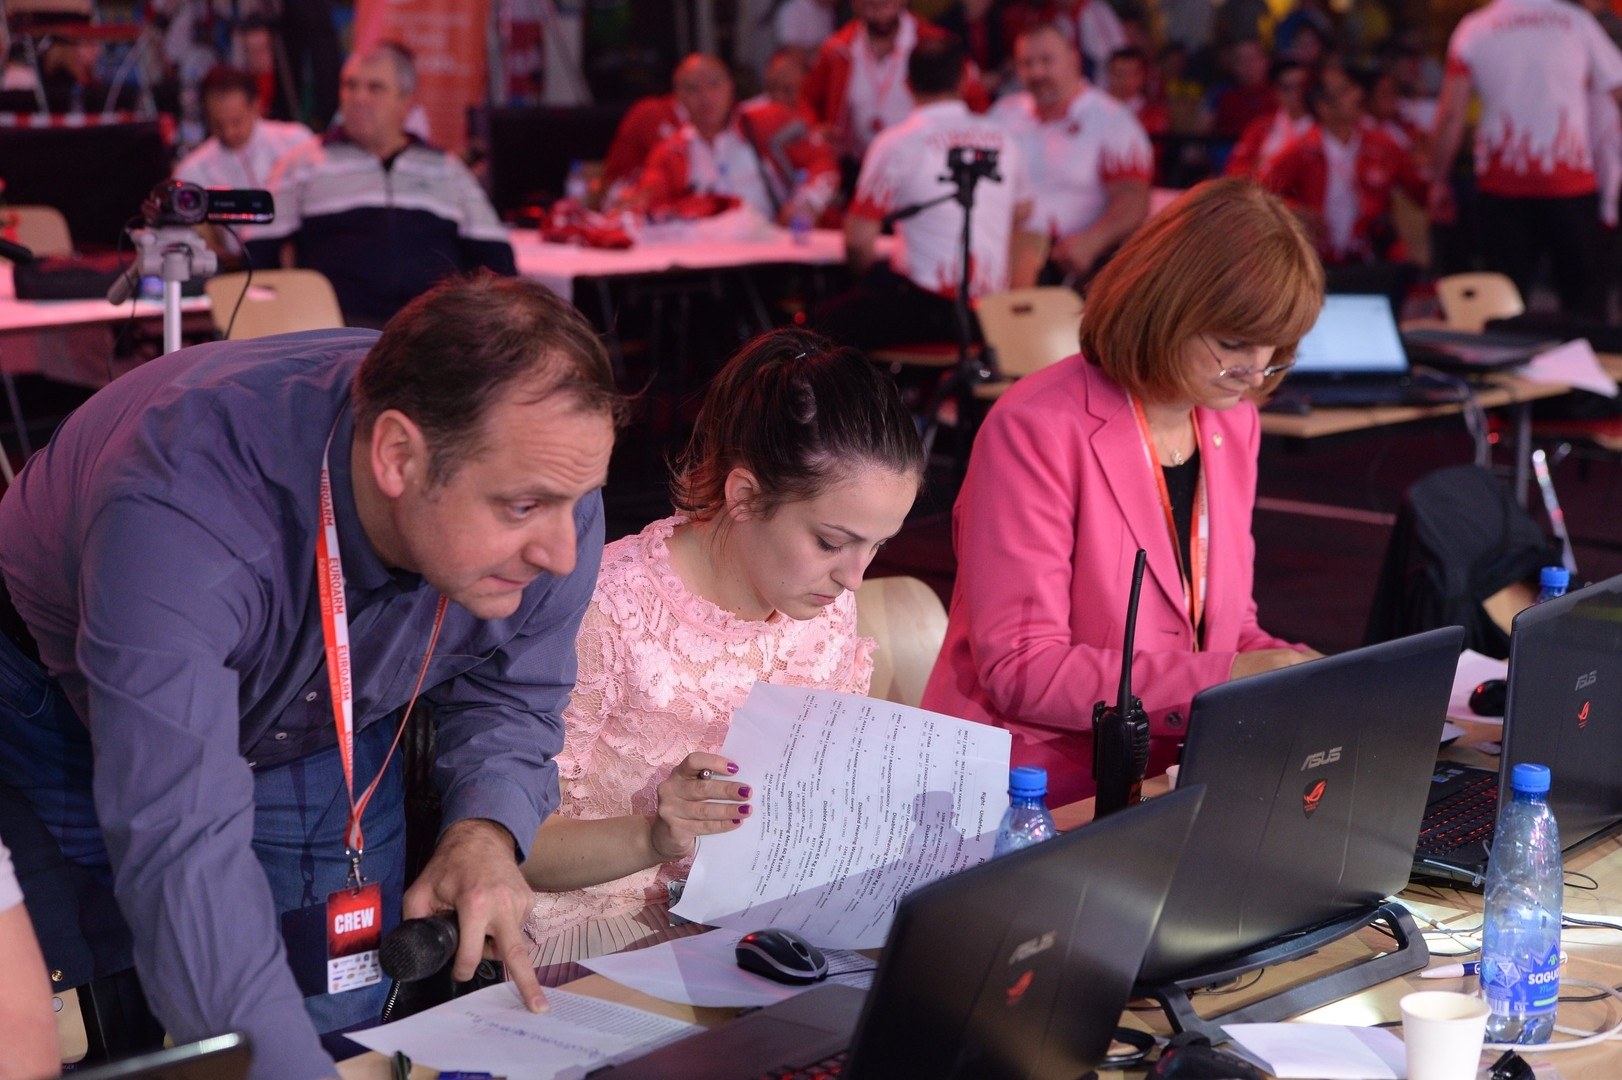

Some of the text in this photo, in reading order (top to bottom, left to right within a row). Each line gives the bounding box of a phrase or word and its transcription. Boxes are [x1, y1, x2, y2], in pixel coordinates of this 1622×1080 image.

[320, 469, 334, 526] EUROARM
[330, 557, 344, 615] EUROARM
[322, 596, 332, 616] 2017
[338, 645, 350, 700] EUROARM
[1575, 670, 1597, 692] ASUS
[1300, 746, 1342, 772] ASUS
[889, 812, 897, 834] Disabled
[975, 810, 984, 841] Undefeated
[852, 824, 860, 845] Hearing
[898, 834, 906, 855] OSTRIKOV
[922, 824, 931, 847] Disabled
[957, 828, 966, 851] Disabled
[846, 846, 856, 866] Women
[883, 835, 893, 856] Hearing
[917, 848, 925, 864] Visual
[811, 859, 817, 867] Kg
[844, 866, 849, 874] 60
[879, 856, 887, 868] Men
[912, 864, 920, 876] Men
[950, 851, 961, 868] Sitting
[836, 881, 844, 891] Left
[840, 873, 847, 881] Kg
[872, 878, 878, 886] Kg
[904, 882, 911, 890] Kg
[334, 907, 374, 934] CREW
